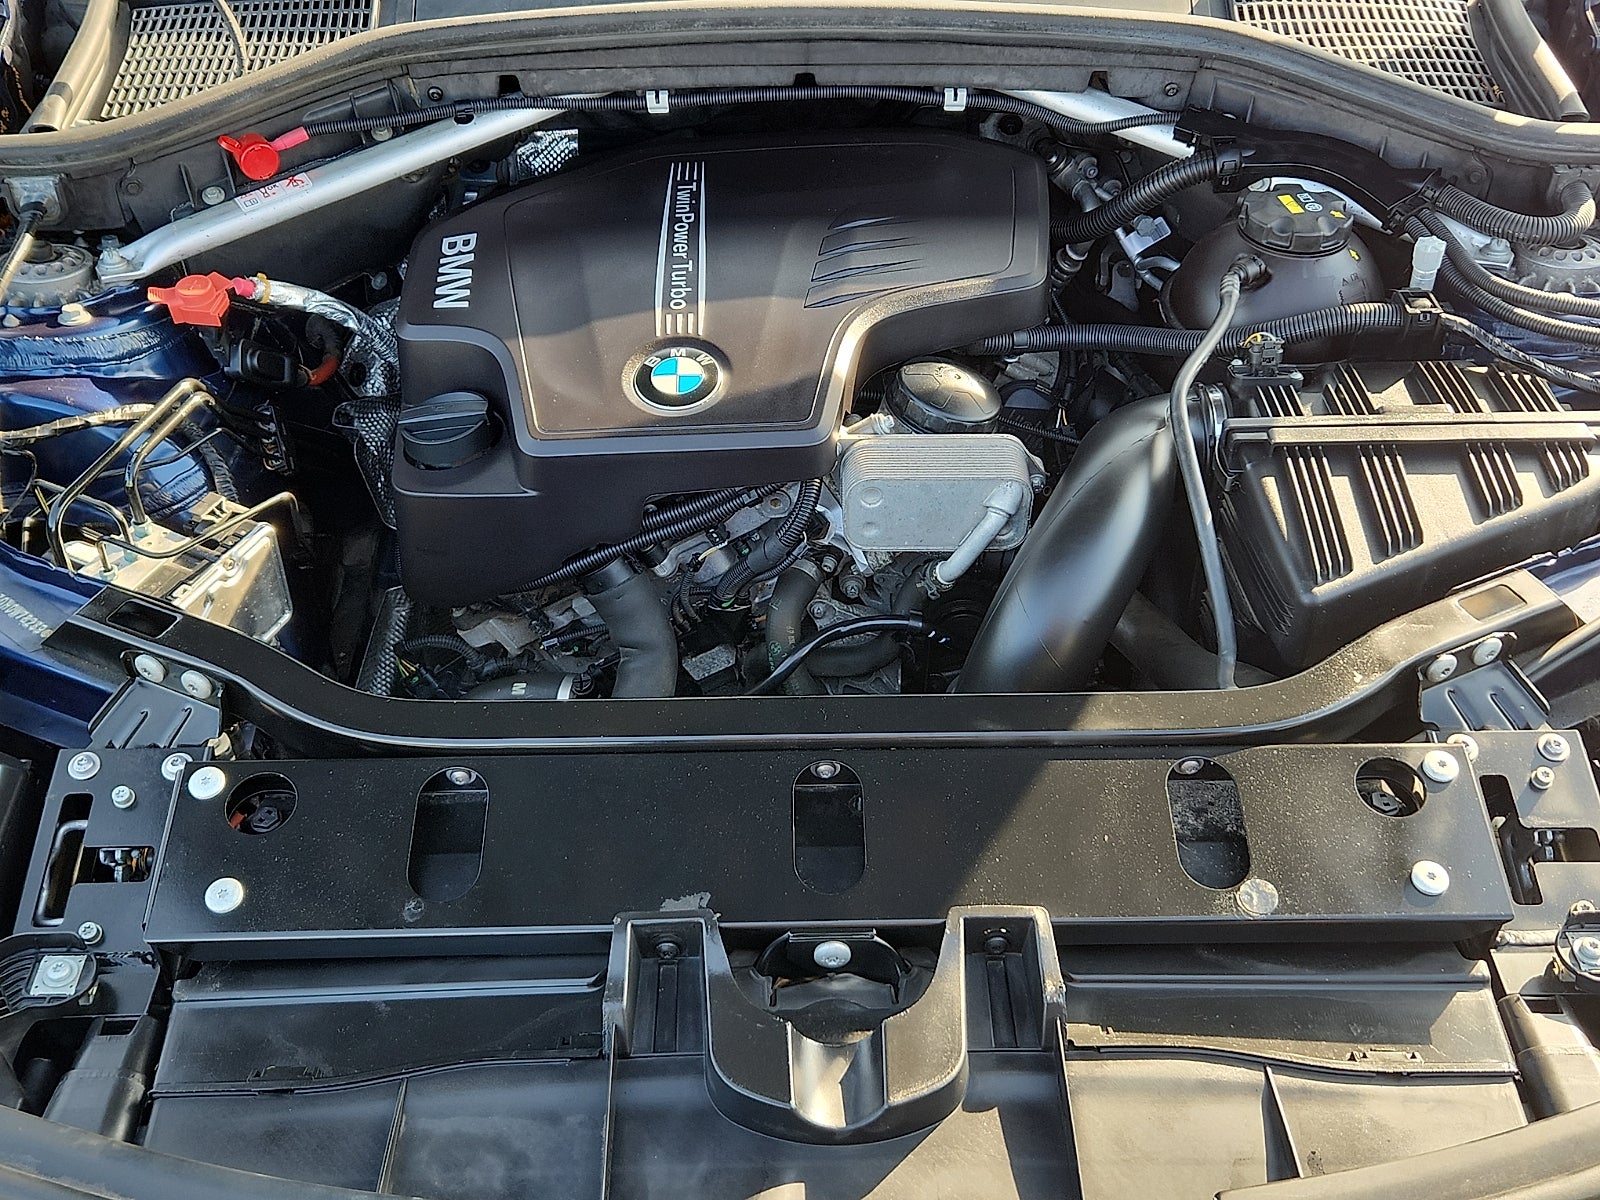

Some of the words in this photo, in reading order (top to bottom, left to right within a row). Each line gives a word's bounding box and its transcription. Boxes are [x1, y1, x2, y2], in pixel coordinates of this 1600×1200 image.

[672, 182, 697, 259] TwinPower
[433, 232, 478, 308] BMW
[669, 260, 693, 310] Turbo
[644, 348, 714, 368] BMW
